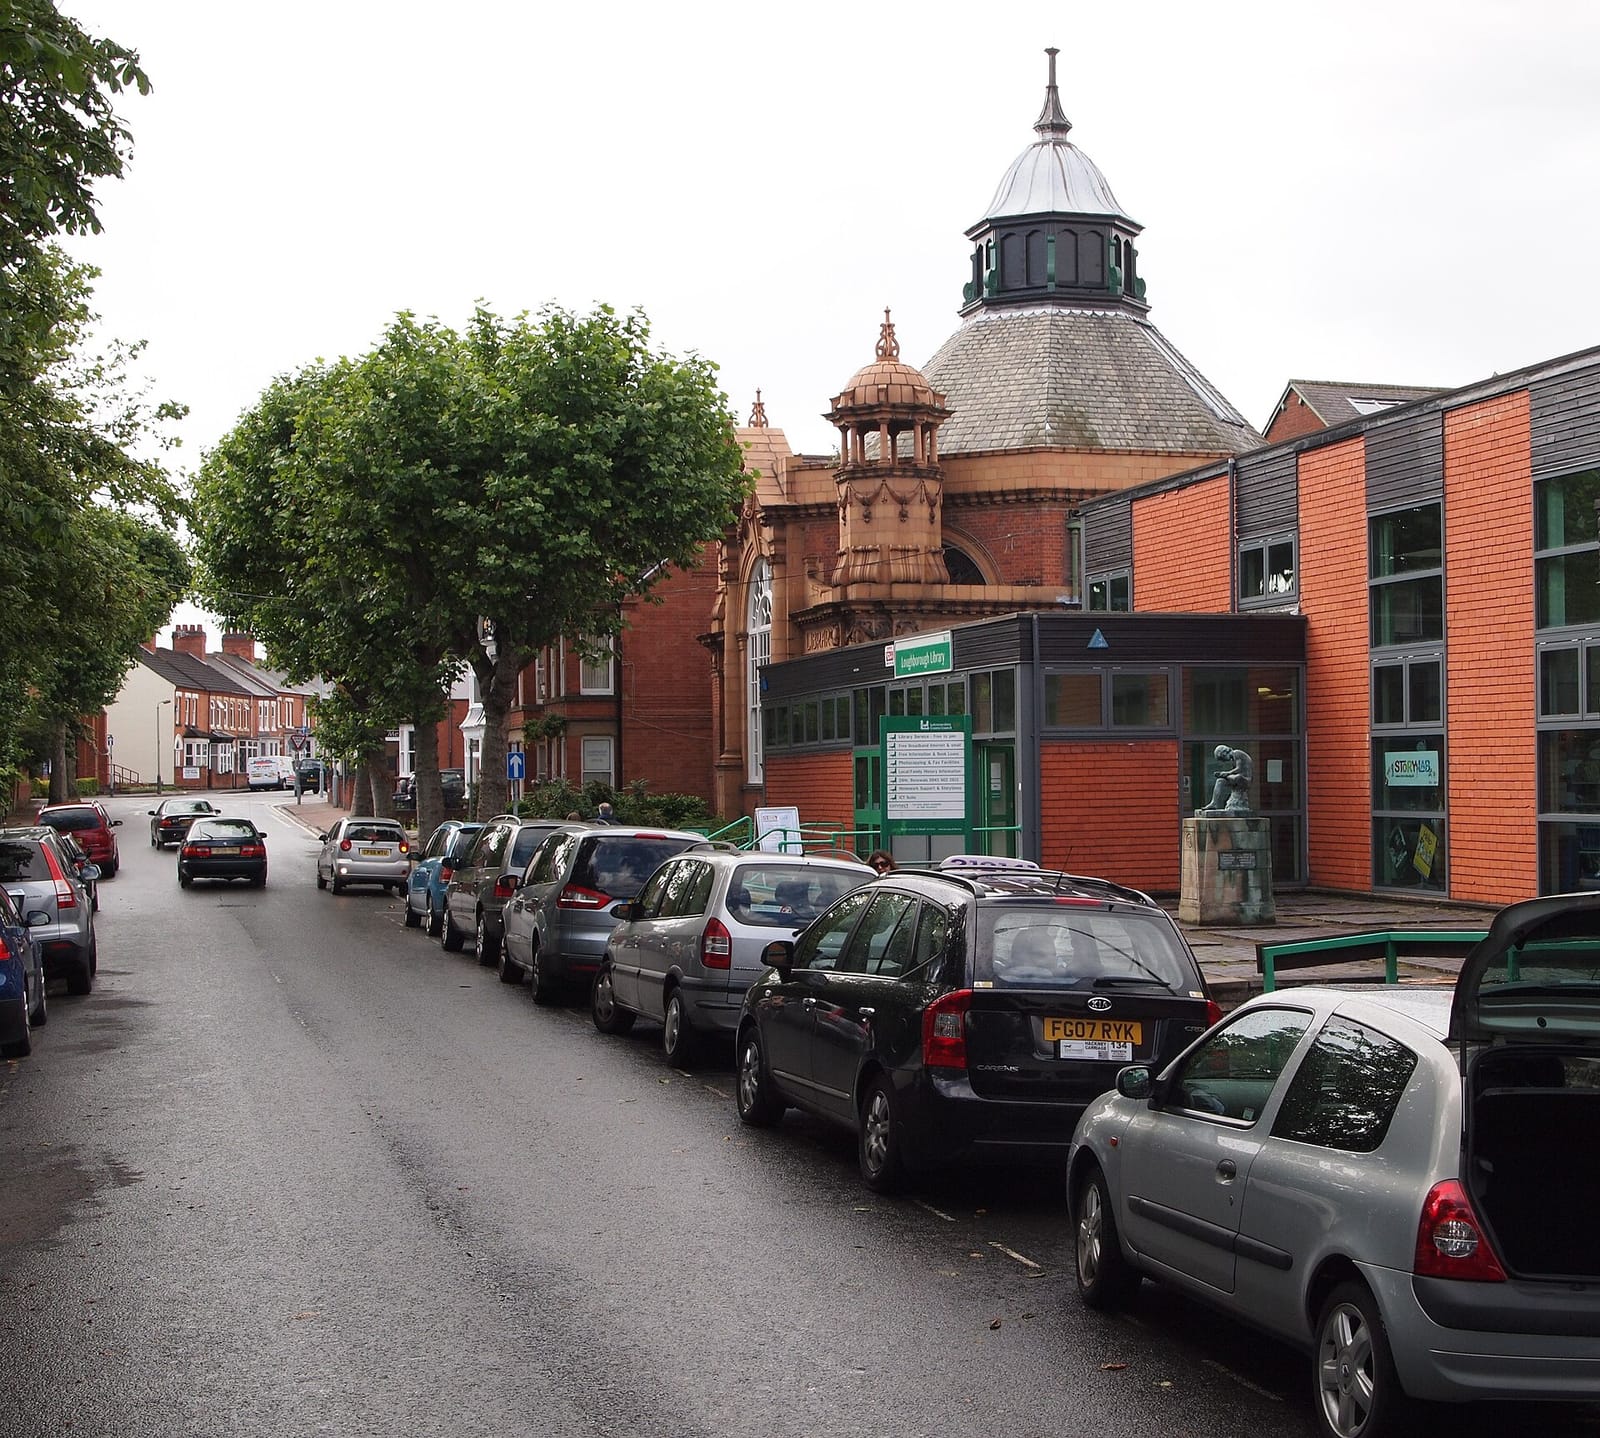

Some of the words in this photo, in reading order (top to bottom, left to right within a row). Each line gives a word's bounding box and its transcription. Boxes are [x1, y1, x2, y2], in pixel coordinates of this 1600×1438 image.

[901, 652, 929, 670] Loughborough
[929, 650, 945, 665] Library
[1051, 1020, 1097, 1038] FG07
[1101, 1022, 1135, 1041] RYK
[1111, 1041, 1128, 1049] 134
